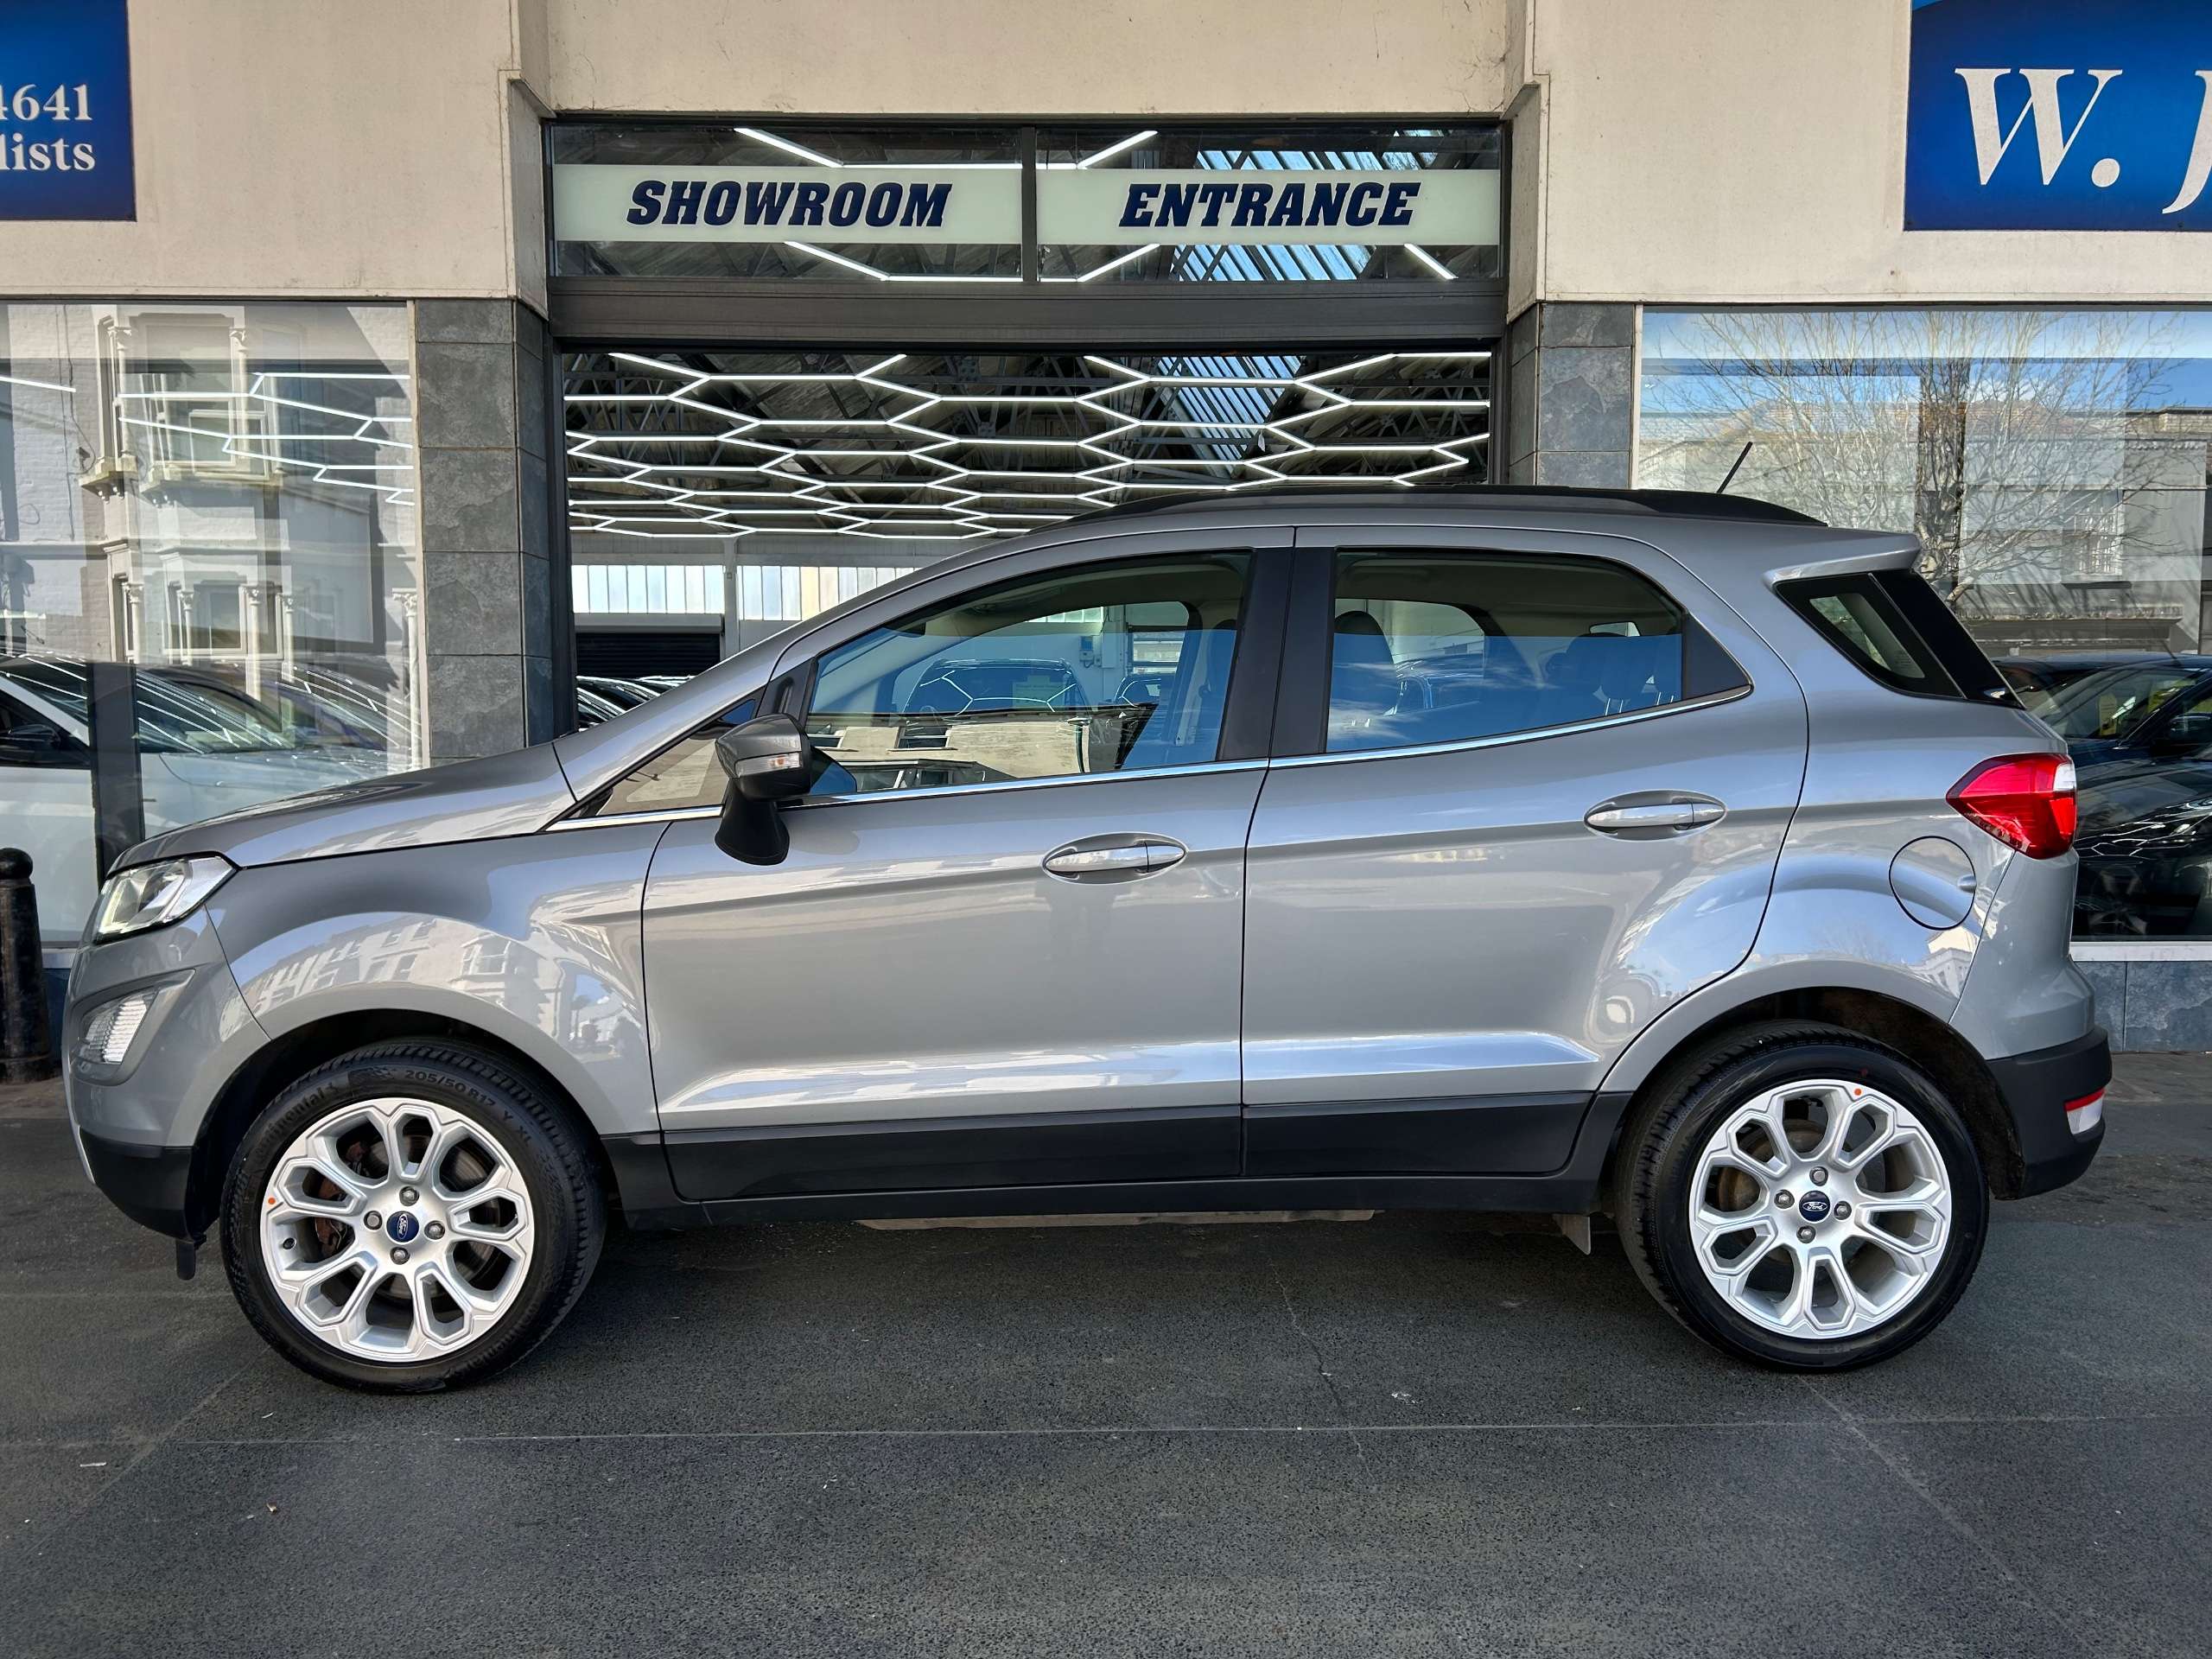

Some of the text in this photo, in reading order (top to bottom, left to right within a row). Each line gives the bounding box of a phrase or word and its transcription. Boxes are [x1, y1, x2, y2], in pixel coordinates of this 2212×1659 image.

[1955, 68, 2123, 188] W.
[0, 132, 96, 171] lists
[626, 180, 1422, 228] SHOWROOM ENTRANCE
[405, 1070, 466, 1093] 205/50
[467, 1088, 497, 1107] R17
[247, 1085, 327, 1166] ntinental
[1804, 1202, 1825, 1211] Ford
